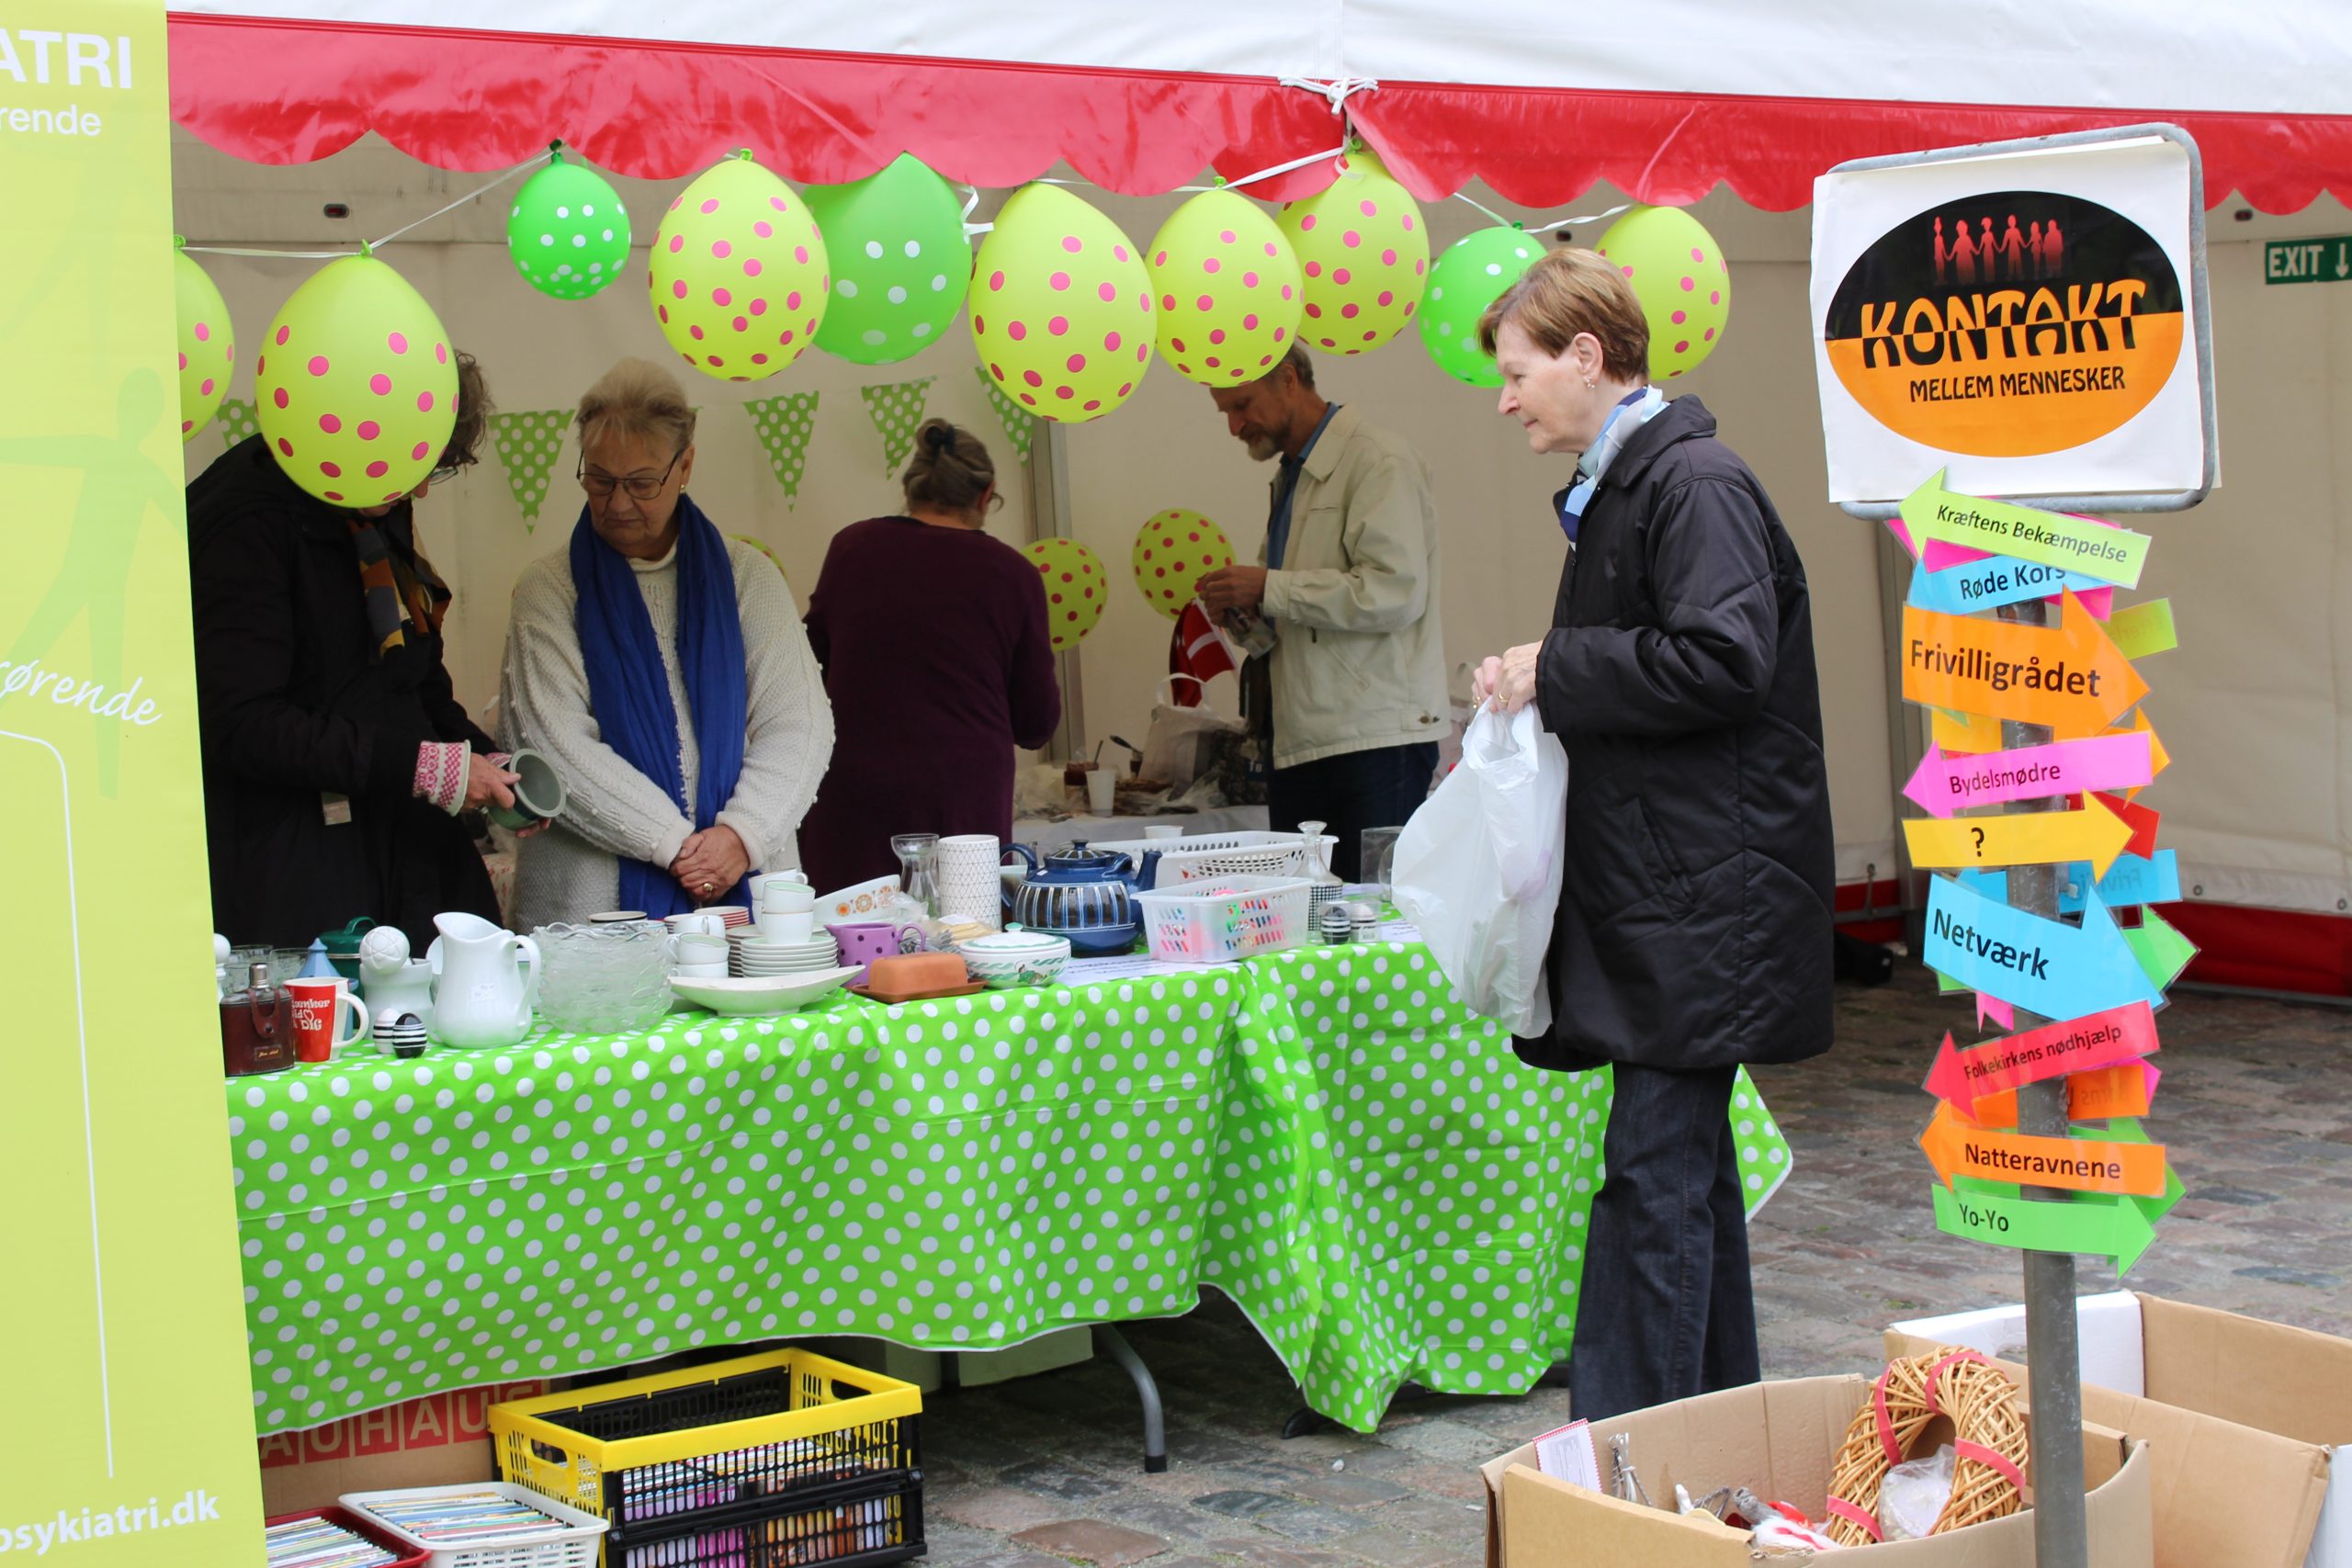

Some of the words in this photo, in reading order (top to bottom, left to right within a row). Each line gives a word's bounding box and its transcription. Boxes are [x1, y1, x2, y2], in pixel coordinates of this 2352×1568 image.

[2268, 244, 2324, 277] EXIT
[1860, 278, 2146, 368] KONTAKT
[1910, 374, 1994, 402] MELLEM
[2000, 366, 2126, 396] MENNESKER
[1937, 504, 2009, 535] Kræftens
[2012, 521, 2128, 563] Bekæmpelse
[1959, 570, 2009, 600] Røde
[1910, 638, 2101, 698] Frivilligrådet
[0, 659, 163, 726] ørende
[1949, 761, 2062, 796] Bydelsmødre
[1970, 827, 1985, 858] ?
[1933, 908, 2051, 981] Netværk
[1962, 1047, 2044, 1081] Folkekirkens
[2046, 1024, 2122, 1057] nødhjælp
[1964, 1143, 2121, 1179] Natteravnene
[1959, 1202, 2009, 1232] Yo-Yo
